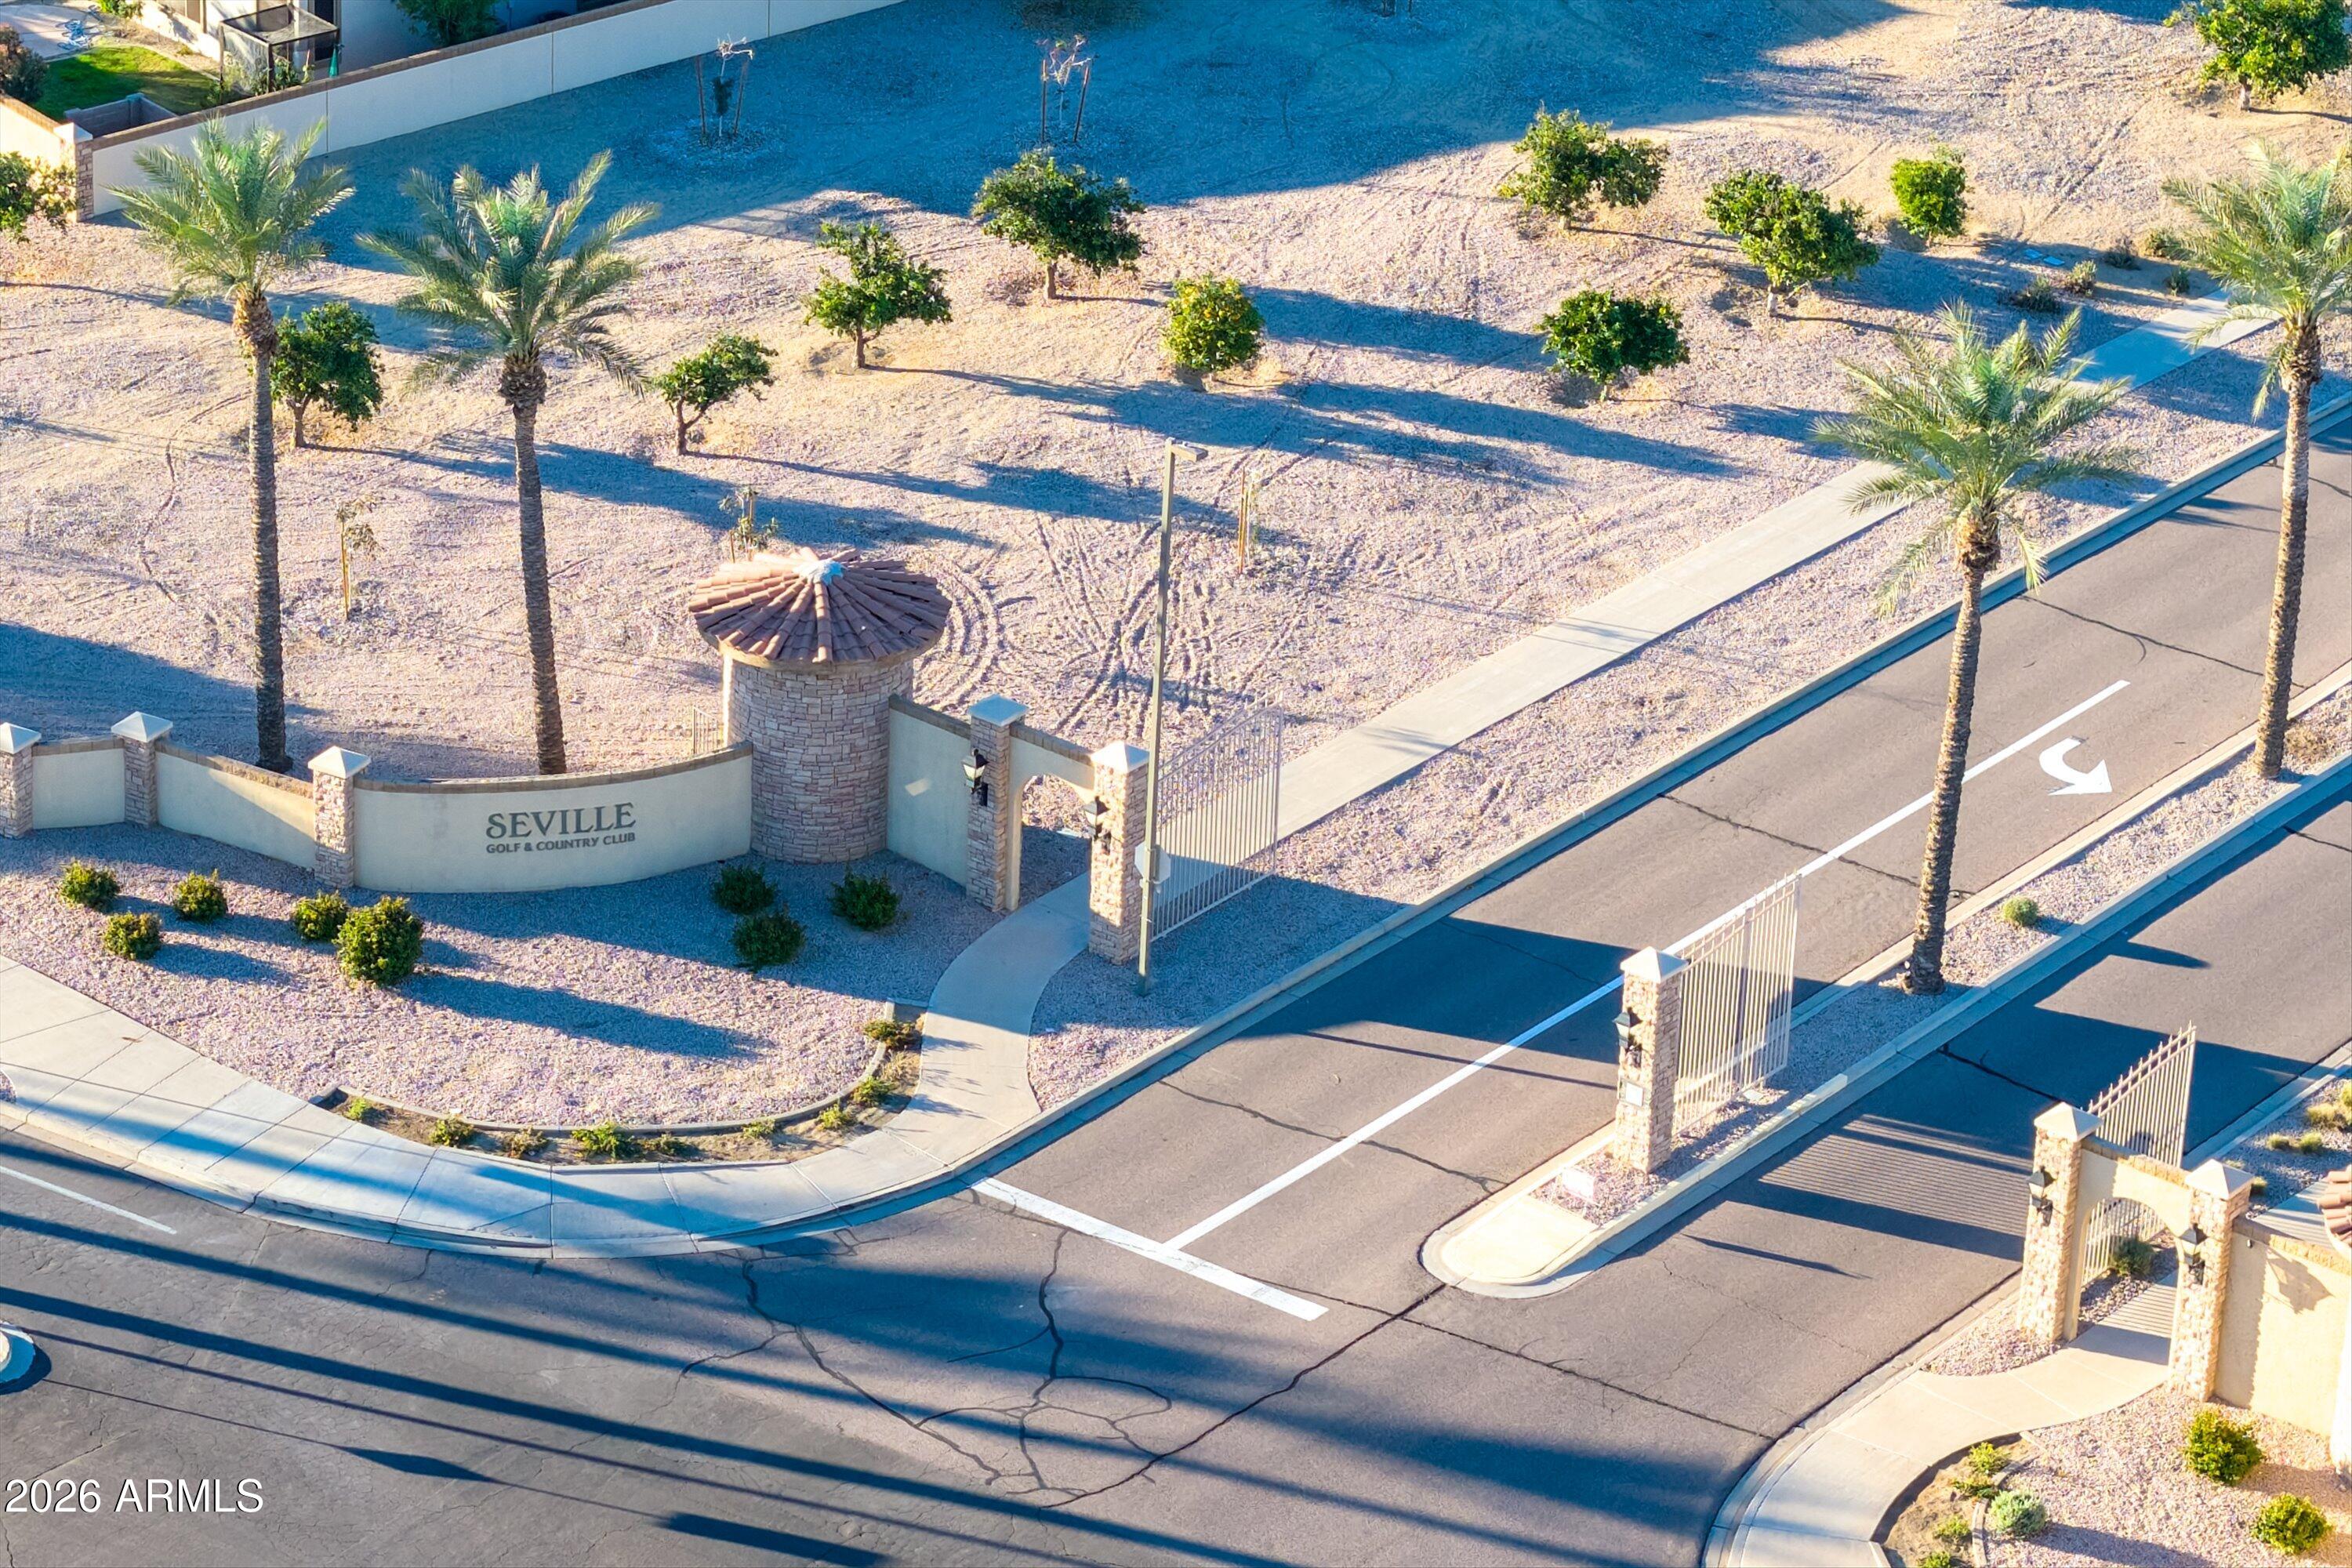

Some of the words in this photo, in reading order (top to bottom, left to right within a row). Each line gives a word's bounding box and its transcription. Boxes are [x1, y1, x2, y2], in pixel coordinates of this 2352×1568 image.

[486, 802, 636, 839] SEVILLE
[486, 842, 521, 854] GOLF
[524, 842, 532, 851] &
[536, 837, 600, 851] COUNTRY
[603, 832, 636, 845] CLUB
